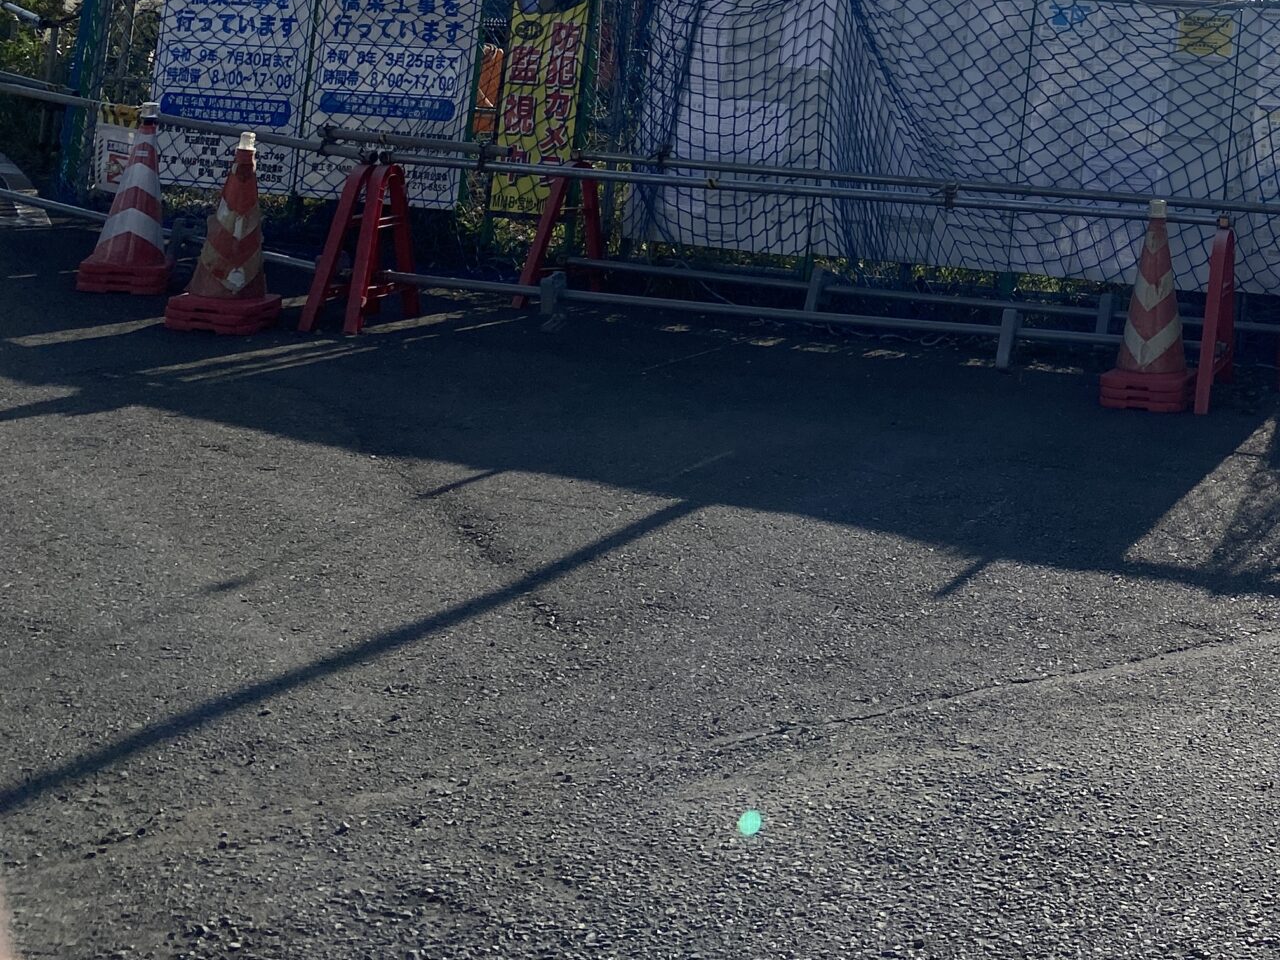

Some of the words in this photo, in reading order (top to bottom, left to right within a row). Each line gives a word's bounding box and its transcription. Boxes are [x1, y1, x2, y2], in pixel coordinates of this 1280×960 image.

[175, 8, 298, 38] 行っています
[333, 14, 463, 43] 行っています
